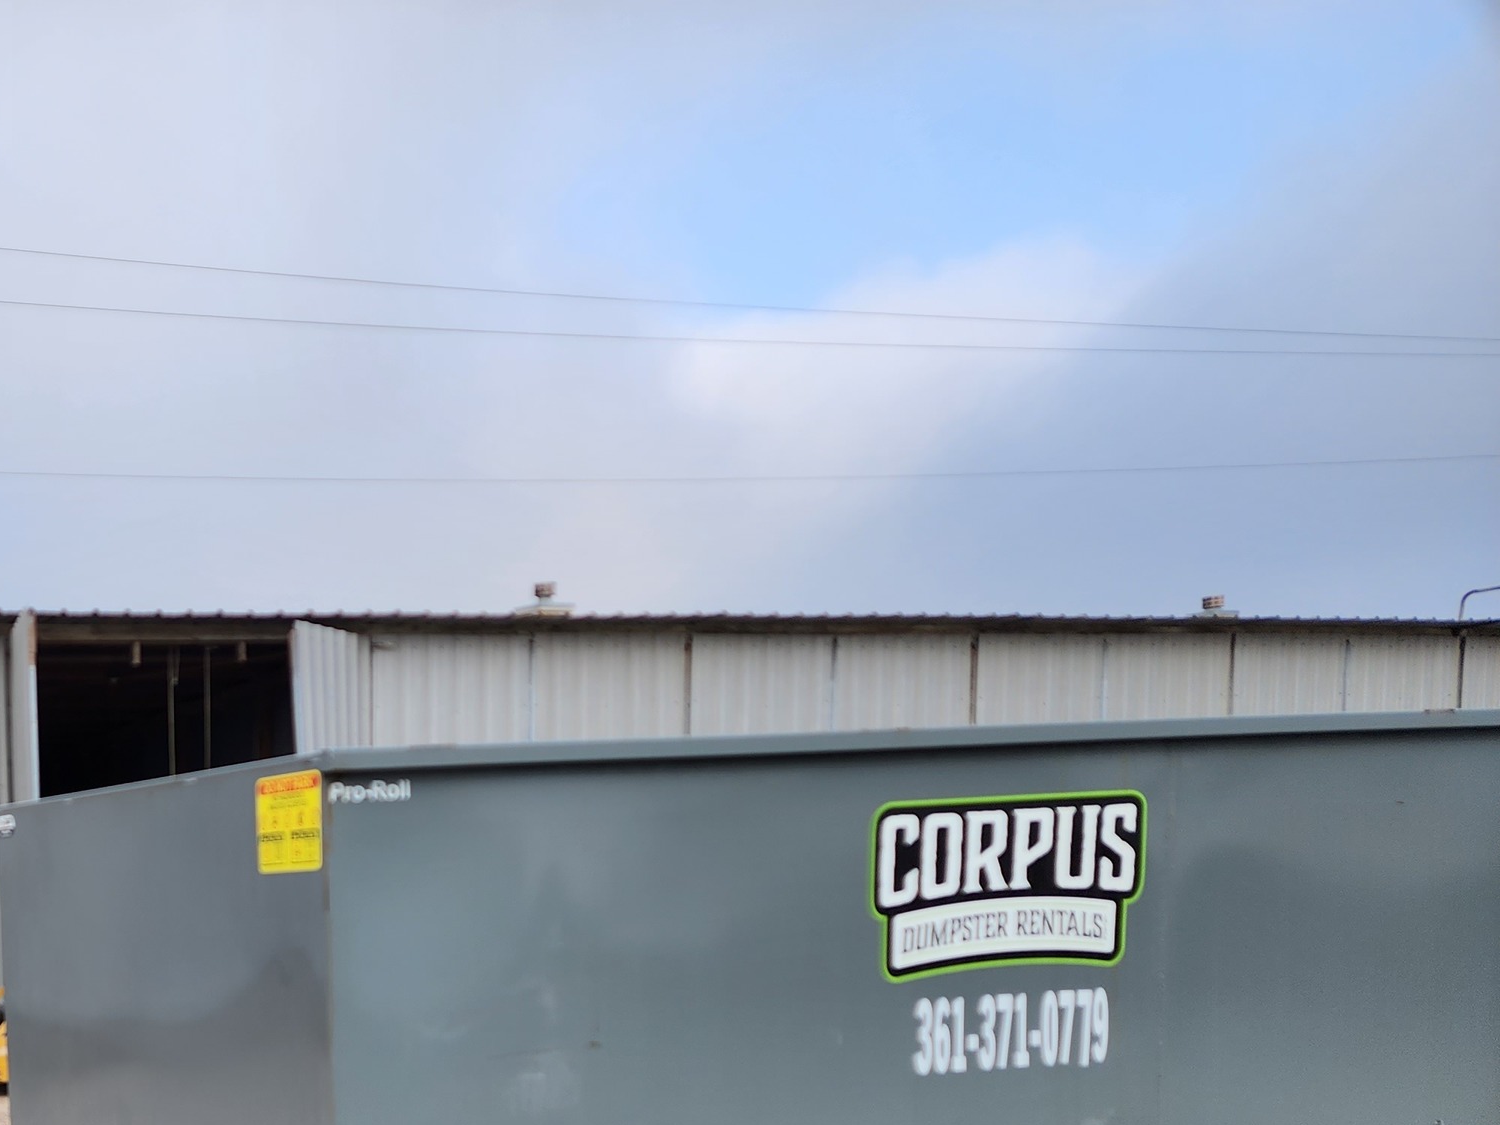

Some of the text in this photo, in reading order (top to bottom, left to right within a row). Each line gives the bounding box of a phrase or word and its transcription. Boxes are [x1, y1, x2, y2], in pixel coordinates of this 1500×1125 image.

[328, 778, 412, 804] Pro-Roll
[877, 802, 1138, 909] CORPUS
[902, 908, 1105, 953] DUMPSTER RENTALS
[912, 987, 1110, 1076] 361-371-0779
